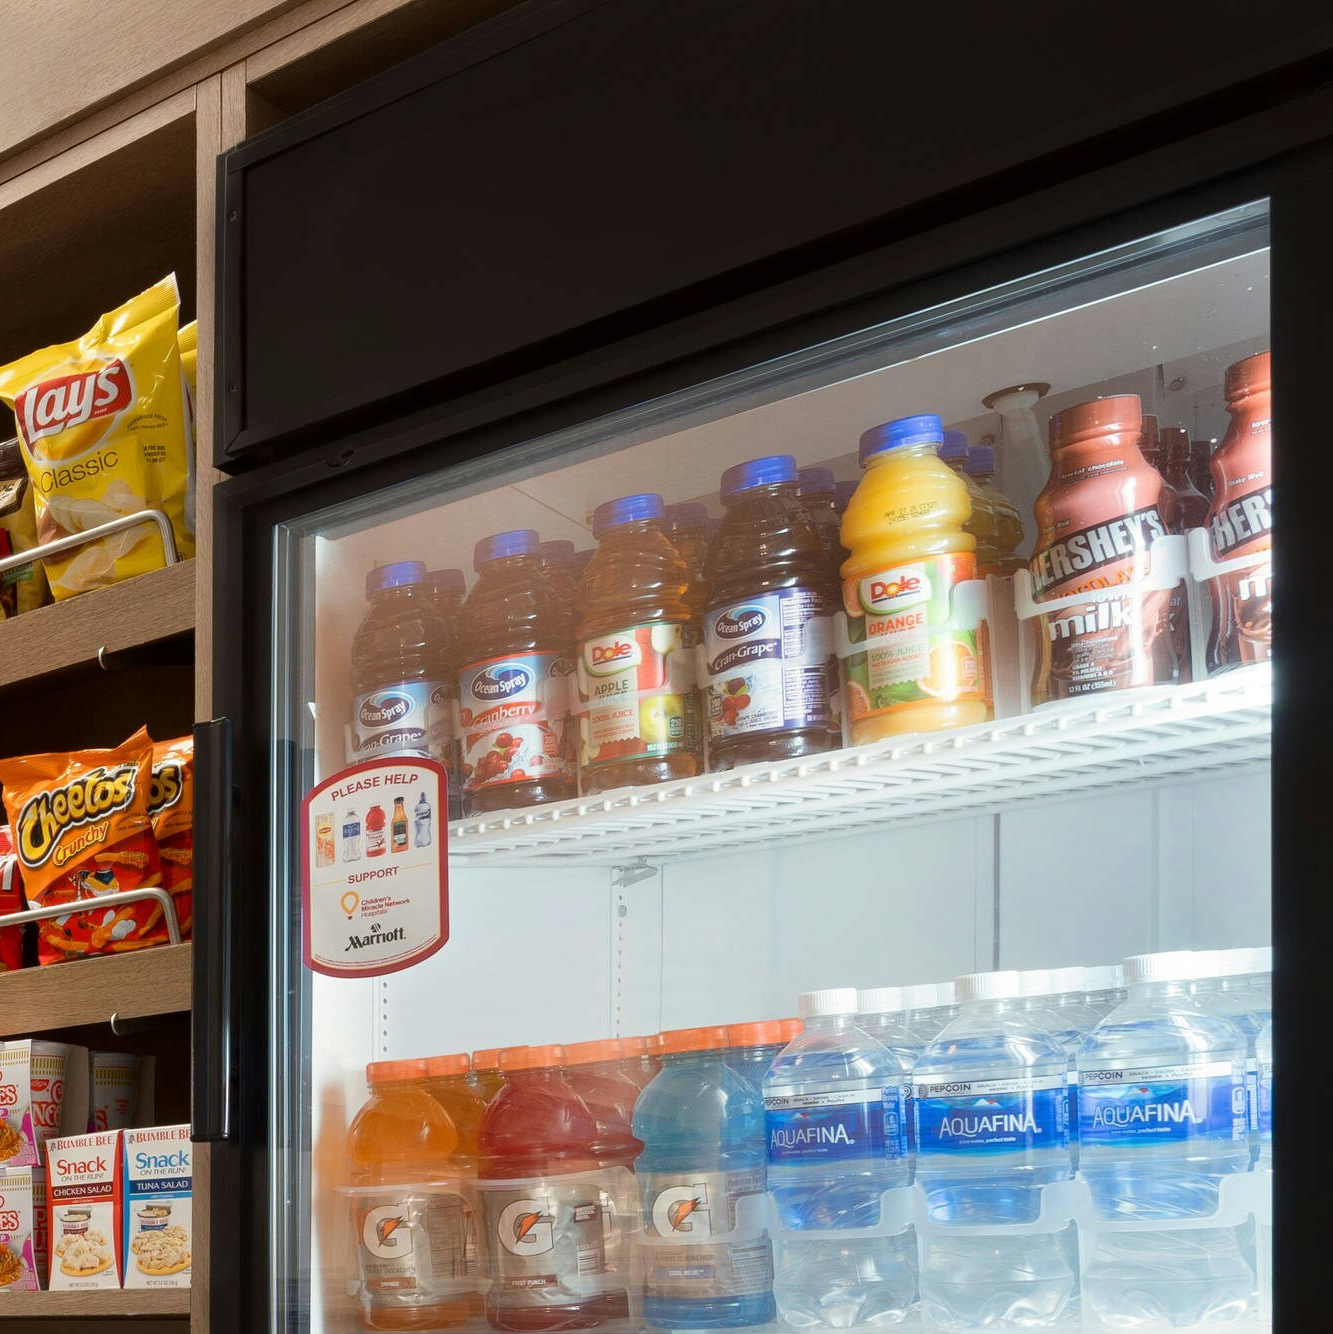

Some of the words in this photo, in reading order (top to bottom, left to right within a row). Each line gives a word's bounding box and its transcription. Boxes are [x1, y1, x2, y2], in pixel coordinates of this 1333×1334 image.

[39, 451, 119, 495] Classic
[1031, 509, 1166, 595] HERSHEY'S
[870, 575, 921, 601] Dole
[716, 620, 739, 635] Ocean
[738, 610, 765, 633] Spray
[868, 613, 924, 636] ORANGE
[1049, 601, 1133, 642] milk
[592, 640, 632, 662] Dole
[715, 641, 775, 671] Cran-Grape
[474, 679, 500, 693] Ocean
[499, 672, 527, 693] Spray
[594, 679, 629, 697] APPLE
[360, 709, 382, 722] Ocean
[381, 700, 406, 719] Spray
[331, 776, 381, 802] PLEASE
[384, 773, 419, 786] HELP
[21, 765, 136, 863] Cheetos
[52, 821, 111, 866] Crunchy
[347, 866, 400, 885] SUPPORT
[360, 895, 392, 906] Children's
[360, 901, 384, 912] Miracle
[384, 898, 411, 909] Network
[344, 926, 405, 952] Marriott
[939, 1111, 1037, 1138] AQUAFINA
[1092, 1099, 1197, 1130] AQUAFINA
[56, 1137, 95, 1151] BUMBLE
[95, 1135, 114, 1146] BEE
[136, 1130, 175, 1144] BUMBLE
[770, 1123, 850, 1150] AQUAFINA
[56, 1156, 107, 1176] Snack
[135, 1150, 190, 1170] Snack
[60, 1174, 72, 1183] ON
[73, 1173, 86, 1182] THE
[136, 1180, 161, 1190] TUNA
[161, 1179, 189, 1189] SALAD
[53, 1186, 87, 1198] CHICKEN
[87, 1184, 112, 1195] SALAD
